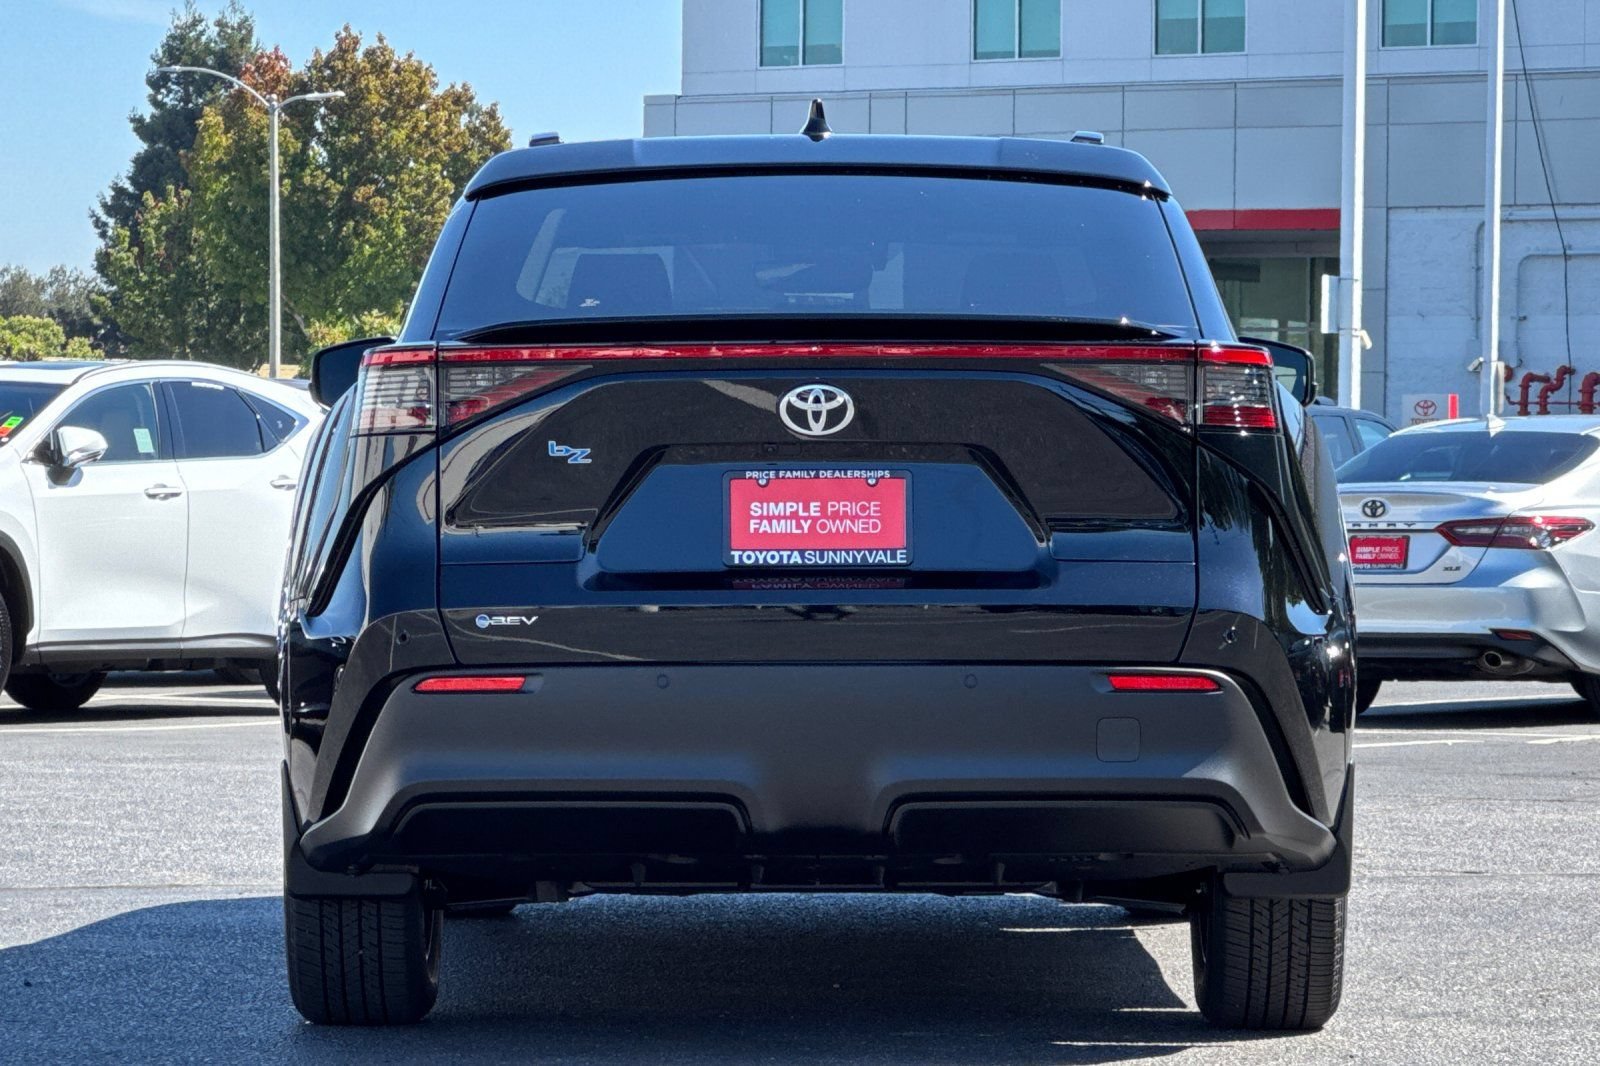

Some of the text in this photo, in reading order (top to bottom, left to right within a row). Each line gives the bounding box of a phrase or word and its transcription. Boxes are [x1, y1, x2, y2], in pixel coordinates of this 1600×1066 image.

[745, 470, 890, 479] PRICE FAMILY DEALERSHIPS
[750, 501, 881, 517] SIMPLE PRICE
[749, 519, 881, 534] FAMILY OWNED
[731, 550, 907, 564] TOYOTA SUNNYVALE
